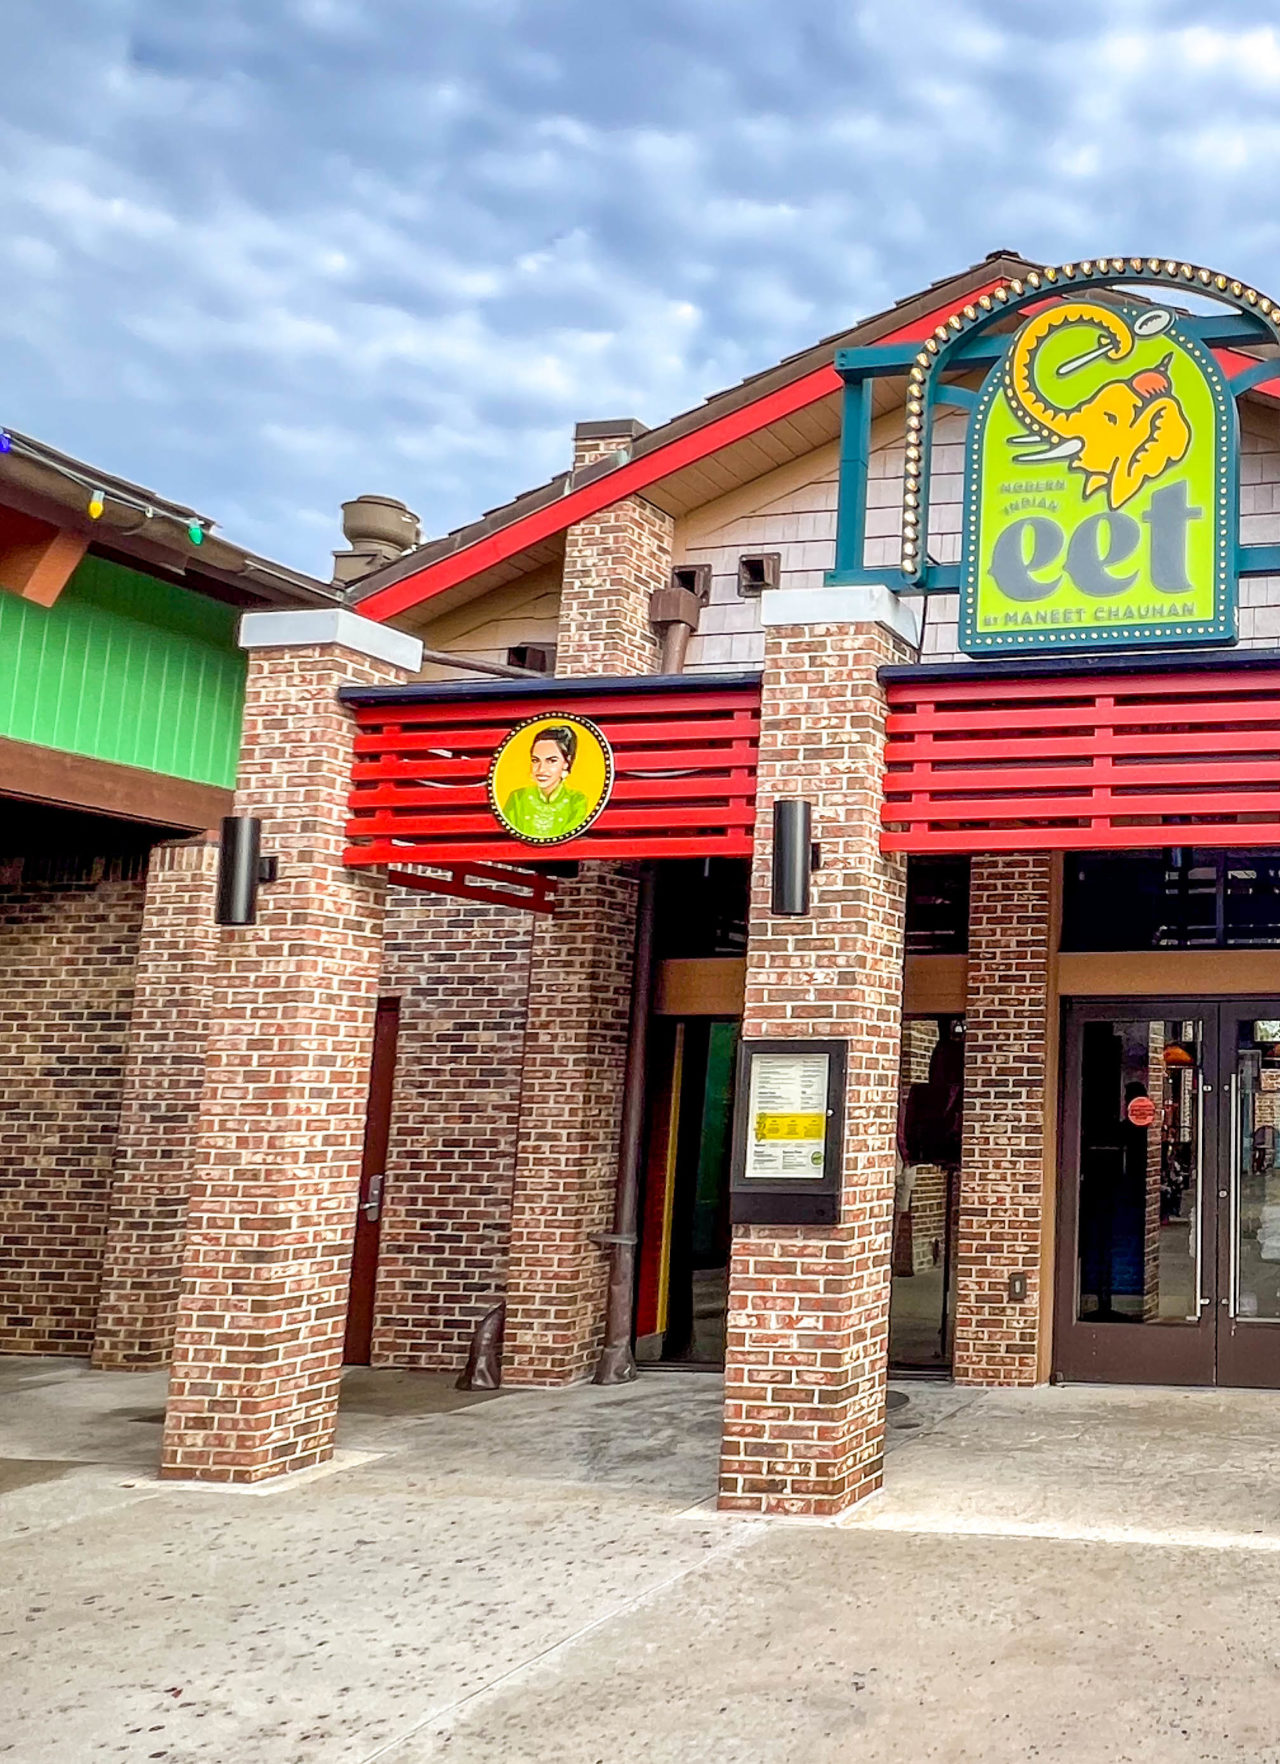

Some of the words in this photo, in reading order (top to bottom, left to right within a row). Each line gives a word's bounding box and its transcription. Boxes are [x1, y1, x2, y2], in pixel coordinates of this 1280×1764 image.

[1000, 479, 1065, 494] MODERN
[1002, 497, 1059, 516] INDIAN
[987, 480, 1202, 602] eet
[983, 616, 998, 626] BY
[1004, 608, 1086, 626] MANEET
[1094, 602, 1195, 622] CHAUHAN
